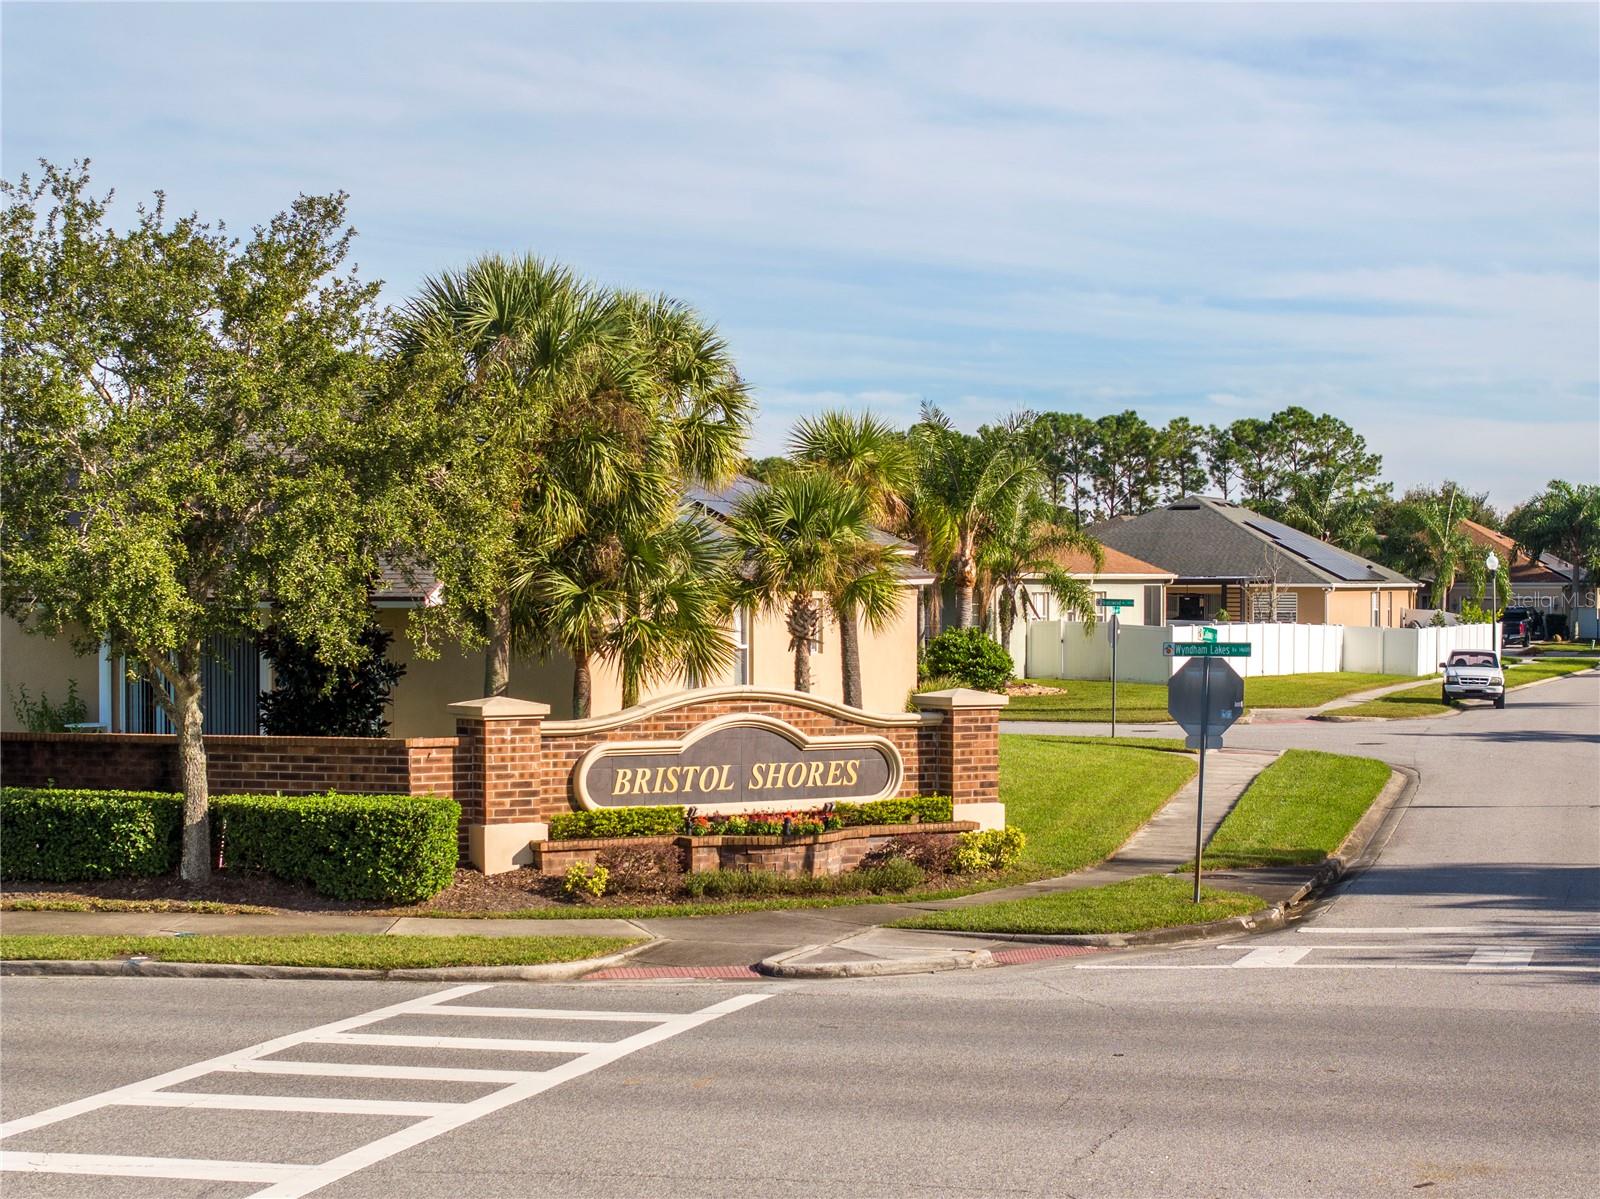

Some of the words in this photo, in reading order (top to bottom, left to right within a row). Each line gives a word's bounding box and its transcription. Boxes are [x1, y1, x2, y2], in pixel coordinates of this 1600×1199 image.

[1175, 644, 1208, 656] Wyndham
[1210, 644, 1230, 655] Lakes
[611, 764, 734, 795] BRISTOL
[748, 760, 860, 789] SHORES
